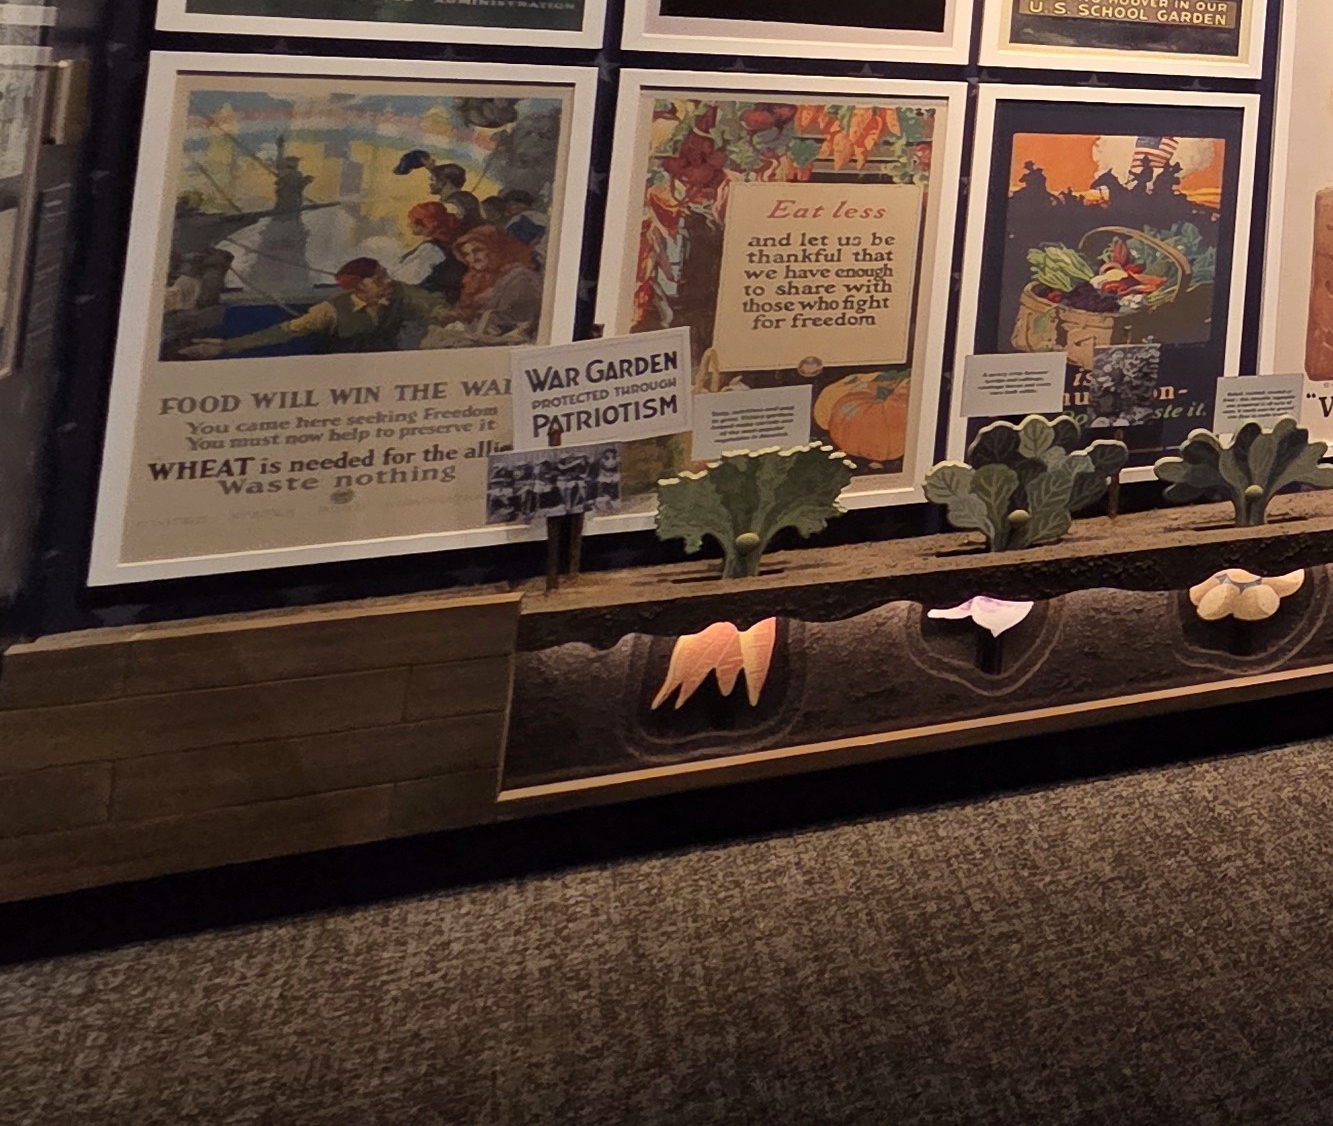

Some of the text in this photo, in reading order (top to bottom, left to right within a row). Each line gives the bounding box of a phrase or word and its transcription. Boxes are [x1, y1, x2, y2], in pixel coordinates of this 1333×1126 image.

[1078, 4, 1227, 26] SCHOOL GARDEN
[1174, 0, 1190, 10] IN
[1196, 1, 1228, 13] OUR
[767, 199, 887, 219] Eat less
[748, 232, 896, 247] and let us be
[746, 248, 894, 264] thankful that
[744, 264, 894, 281] we have enough
[744, 279, 893, 297] to share with
[742, 295, 890, 314] those who fight
[752, 312, 876, 330] for freedom
[525, 351, 678, 393] WAR GARDEN
[159, 394, 241, 416] FOOD
[251, 389, 320, 410] WILL
[329, 385, 383, 405] WIN
[394, 382, 448, 402] THE
[531, 378, 677, 410] PROTECTED THROUGH
[186, 405, 498, 437] You came here seeking Freedom
[533, 394, 678, 438] PATRIOTISM
[148, 443, 458, 481] WHEAT is needed for the
[218, 465, 457, 496] Waste nothing
